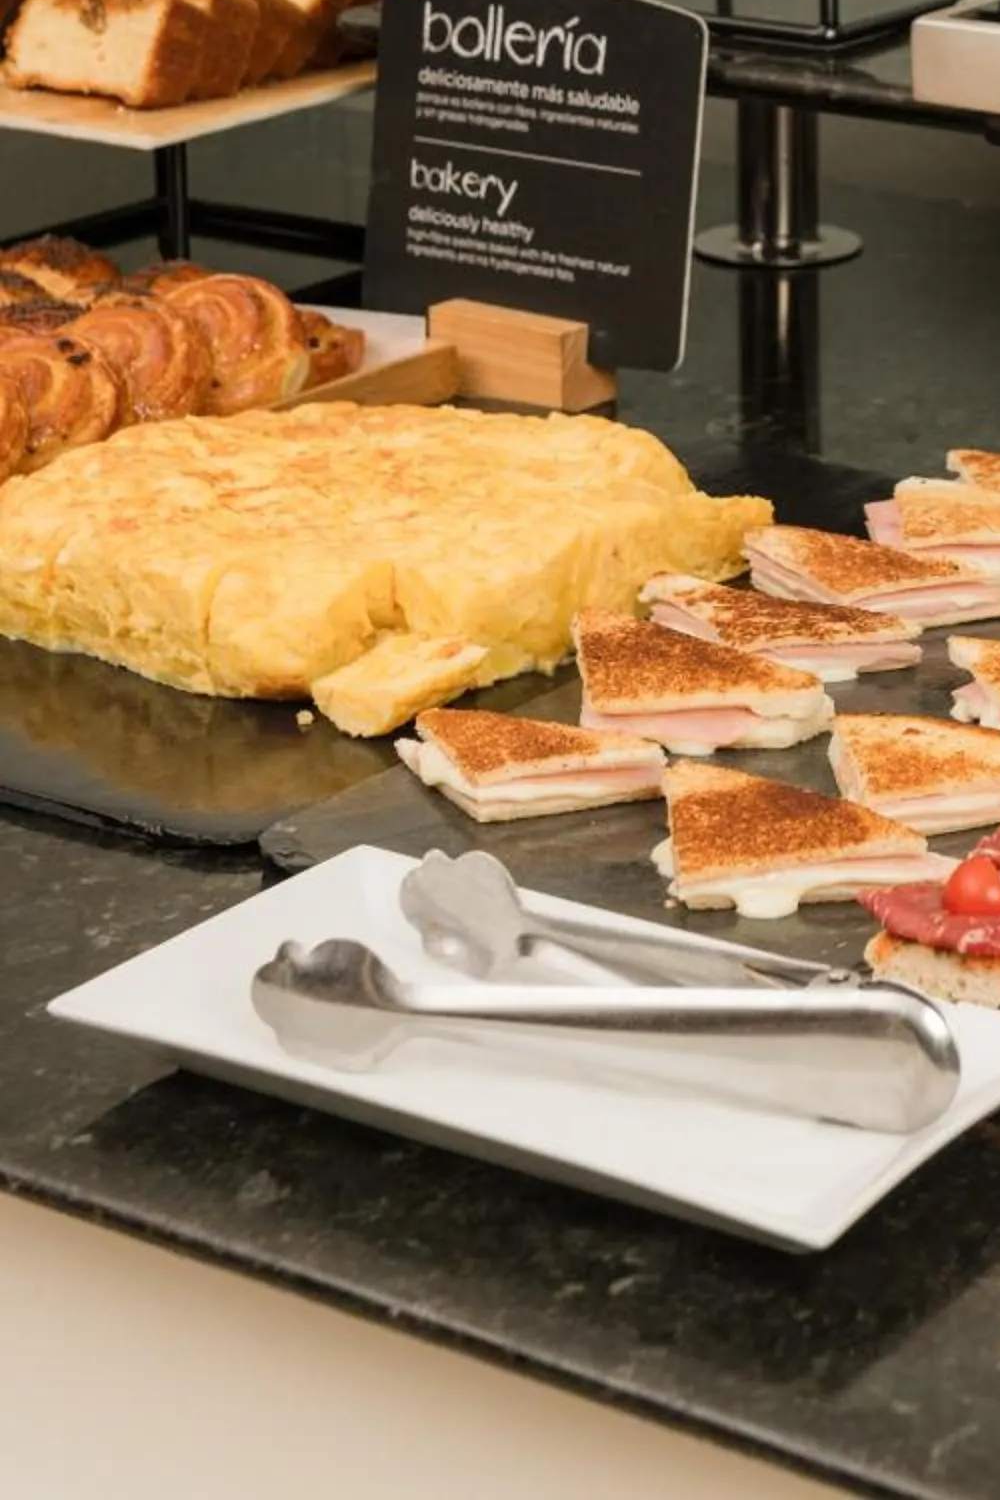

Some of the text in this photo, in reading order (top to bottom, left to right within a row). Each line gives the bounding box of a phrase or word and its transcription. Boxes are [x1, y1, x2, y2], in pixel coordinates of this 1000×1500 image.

[421, 1, 608, 76] bollería
[417, 65, 640, 116] deliciosamente más saludable
[410, 158, 518, 217] bakery
[408, 204, 535, 245] deliciously healthy
